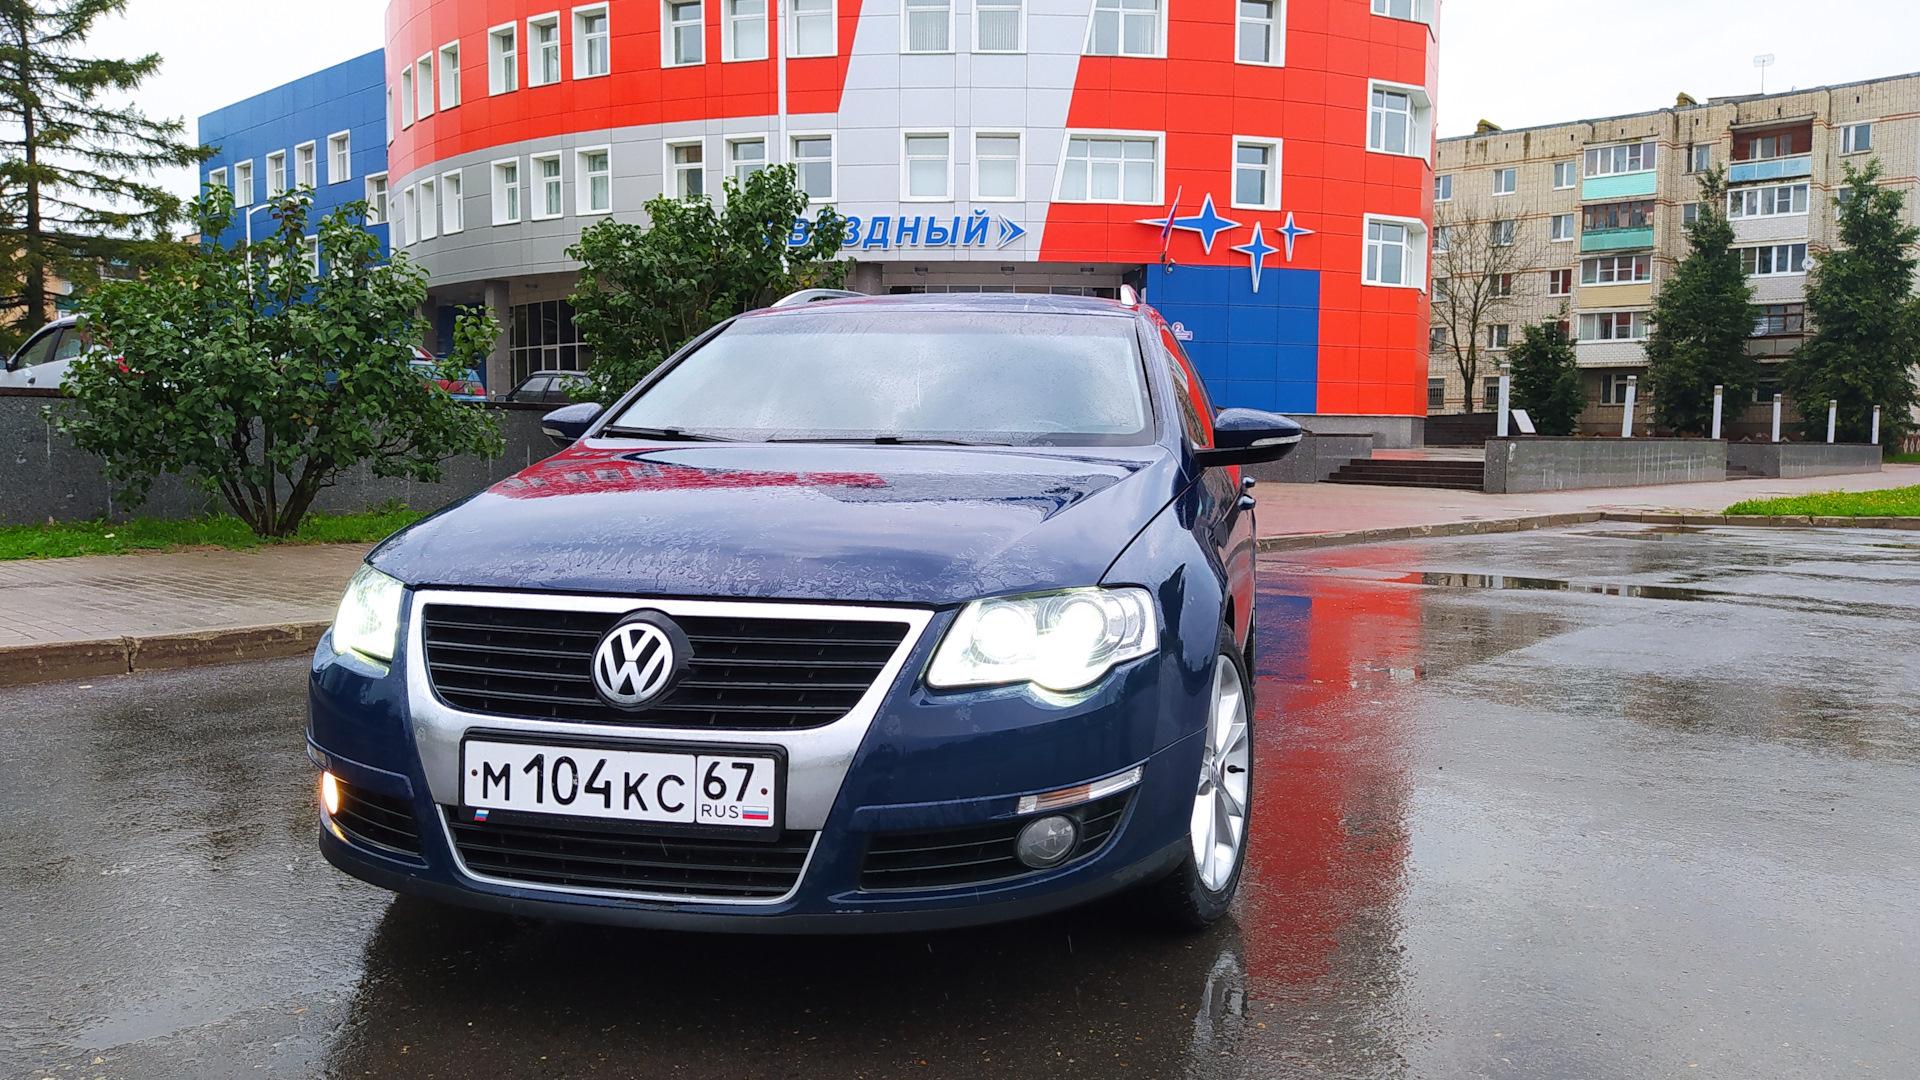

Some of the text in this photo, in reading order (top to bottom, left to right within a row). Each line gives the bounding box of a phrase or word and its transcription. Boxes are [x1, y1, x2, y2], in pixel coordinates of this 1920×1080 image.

[760, 208, 990, 249] ВЗДНЫЙ
[596, 624, 672, 702] VW
[703, 761, 754, 802] 67
[701, 803, 739, 818] RUS
